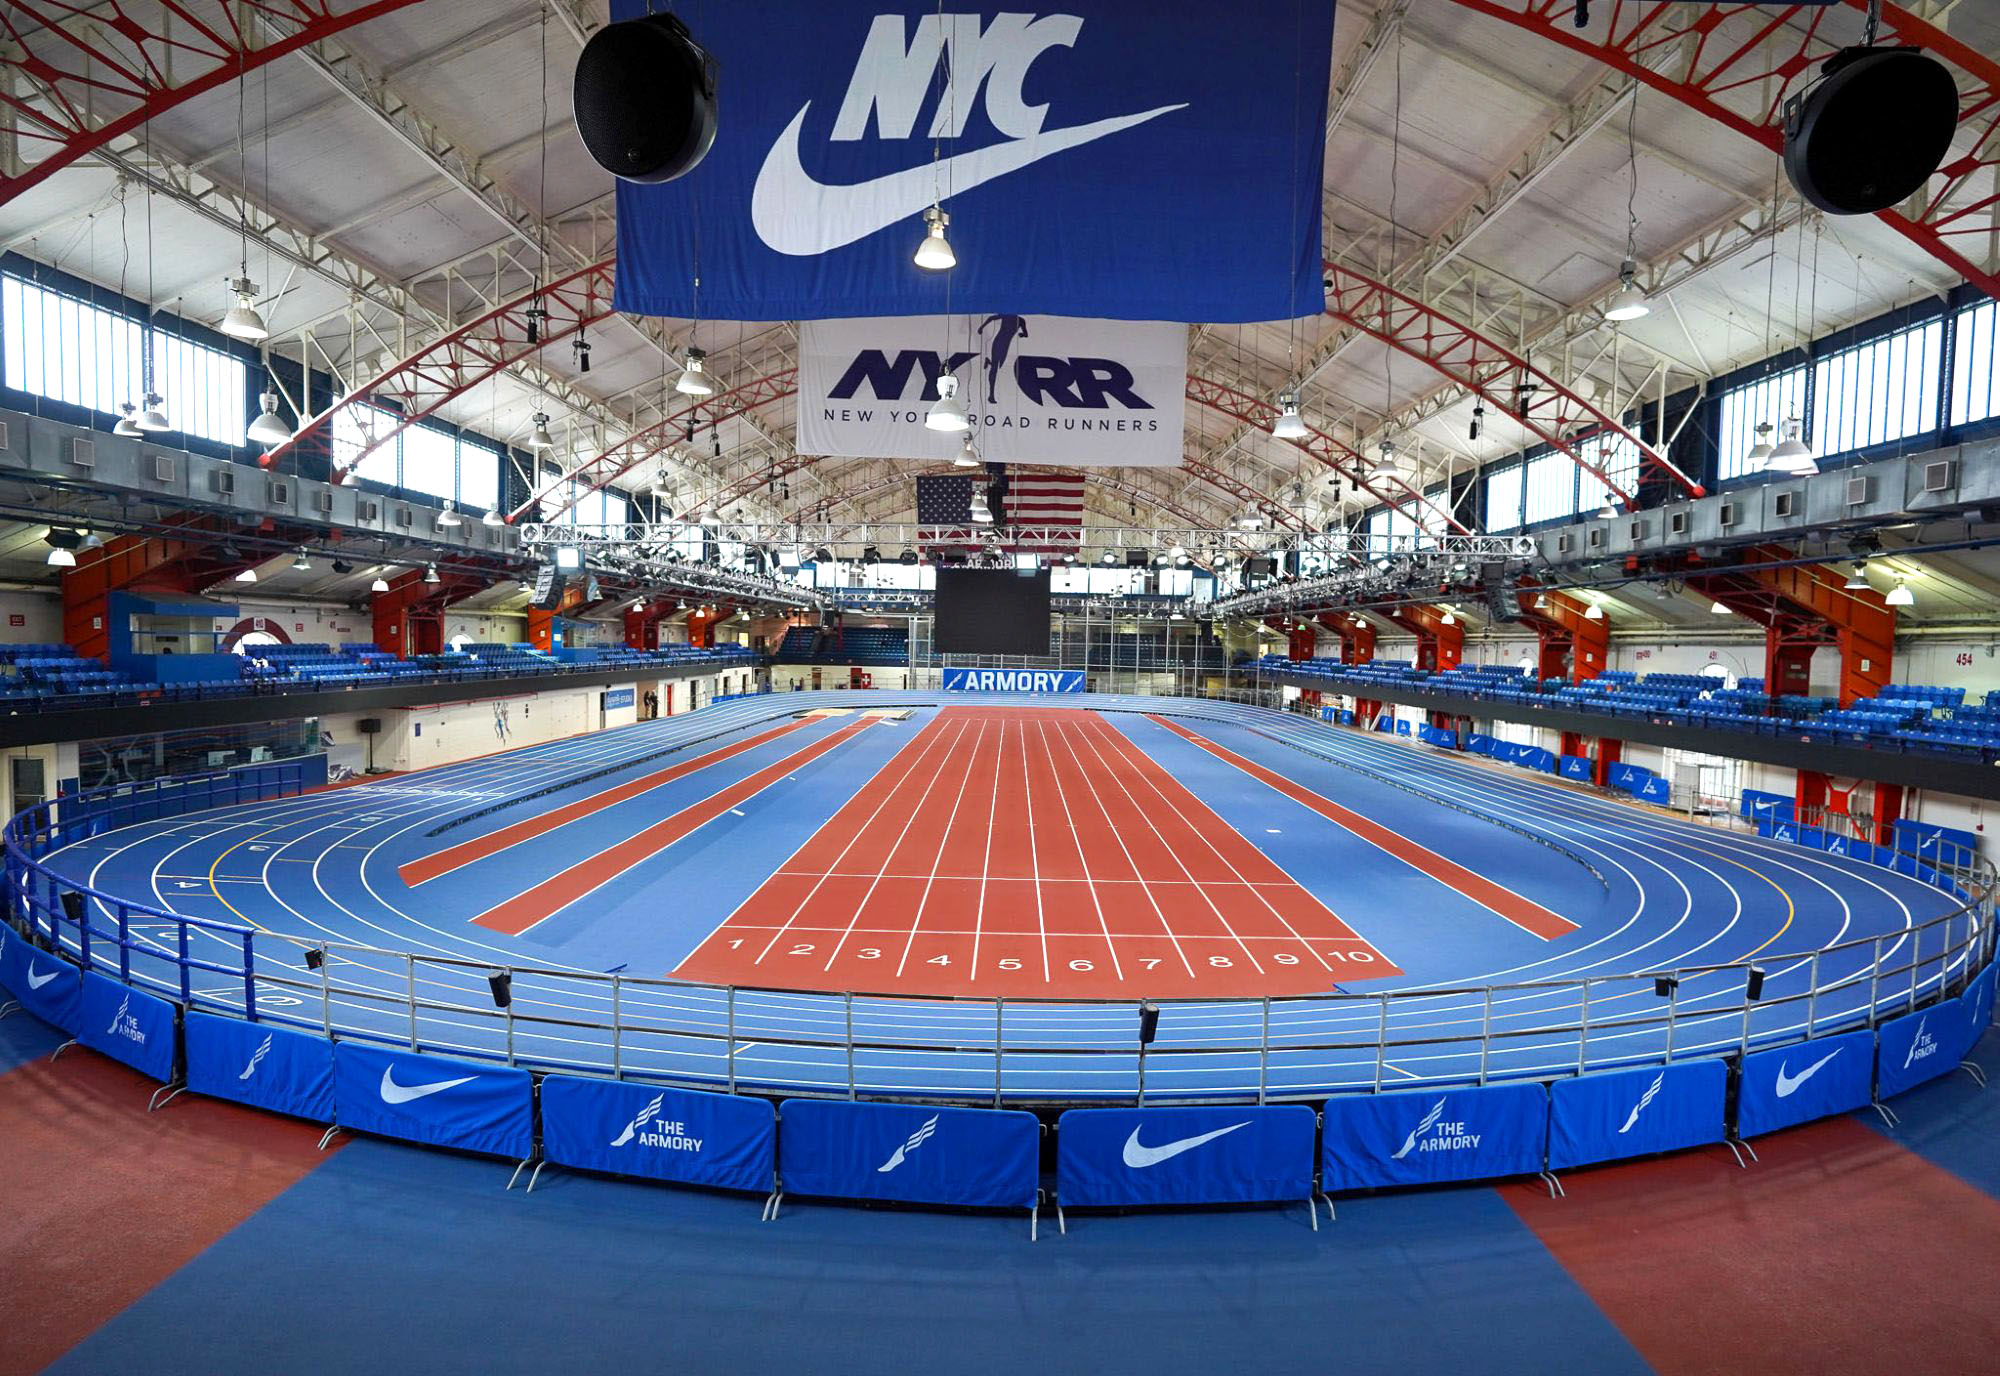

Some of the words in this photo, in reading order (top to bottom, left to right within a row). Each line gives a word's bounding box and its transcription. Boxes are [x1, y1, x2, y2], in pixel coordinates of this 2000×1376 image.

[830, 12, 1084, 141] NYC
[824, 408, 874, 423] NEW
[968, 414, 1031, 429] ROAD
[1048, 417, 1158, 432] RUNNERS
[1956, 652, 1973, 666] 454
[964, 671, 1064, 692] ARMORY
[728, 938, 745, 950] 1
[788, 943, 816, 956] 2
[856, 947, 882, 960] 3
[1273, 953, 1300, 966] 9
[1327, 950, 1375, 963] 10
[926, 954, 952, 967] 4
[998, 958, 1023, 971] 5
[1068, 959, 1095, 972] 6
[1138, 957, 1163, 970] 7
[1208, 955, 1234, 968] 8
[125, 1014, 138, 1030] THE
[118, 1023, 146, 1045] ARMORY
[656, 1119, 684, 1135] THE
[1436, 1122, 1464, 1136] THE
[639, 1132, 702, 1151] ARMORY
[1419, 1134, 1480, 1152] ARMORY
